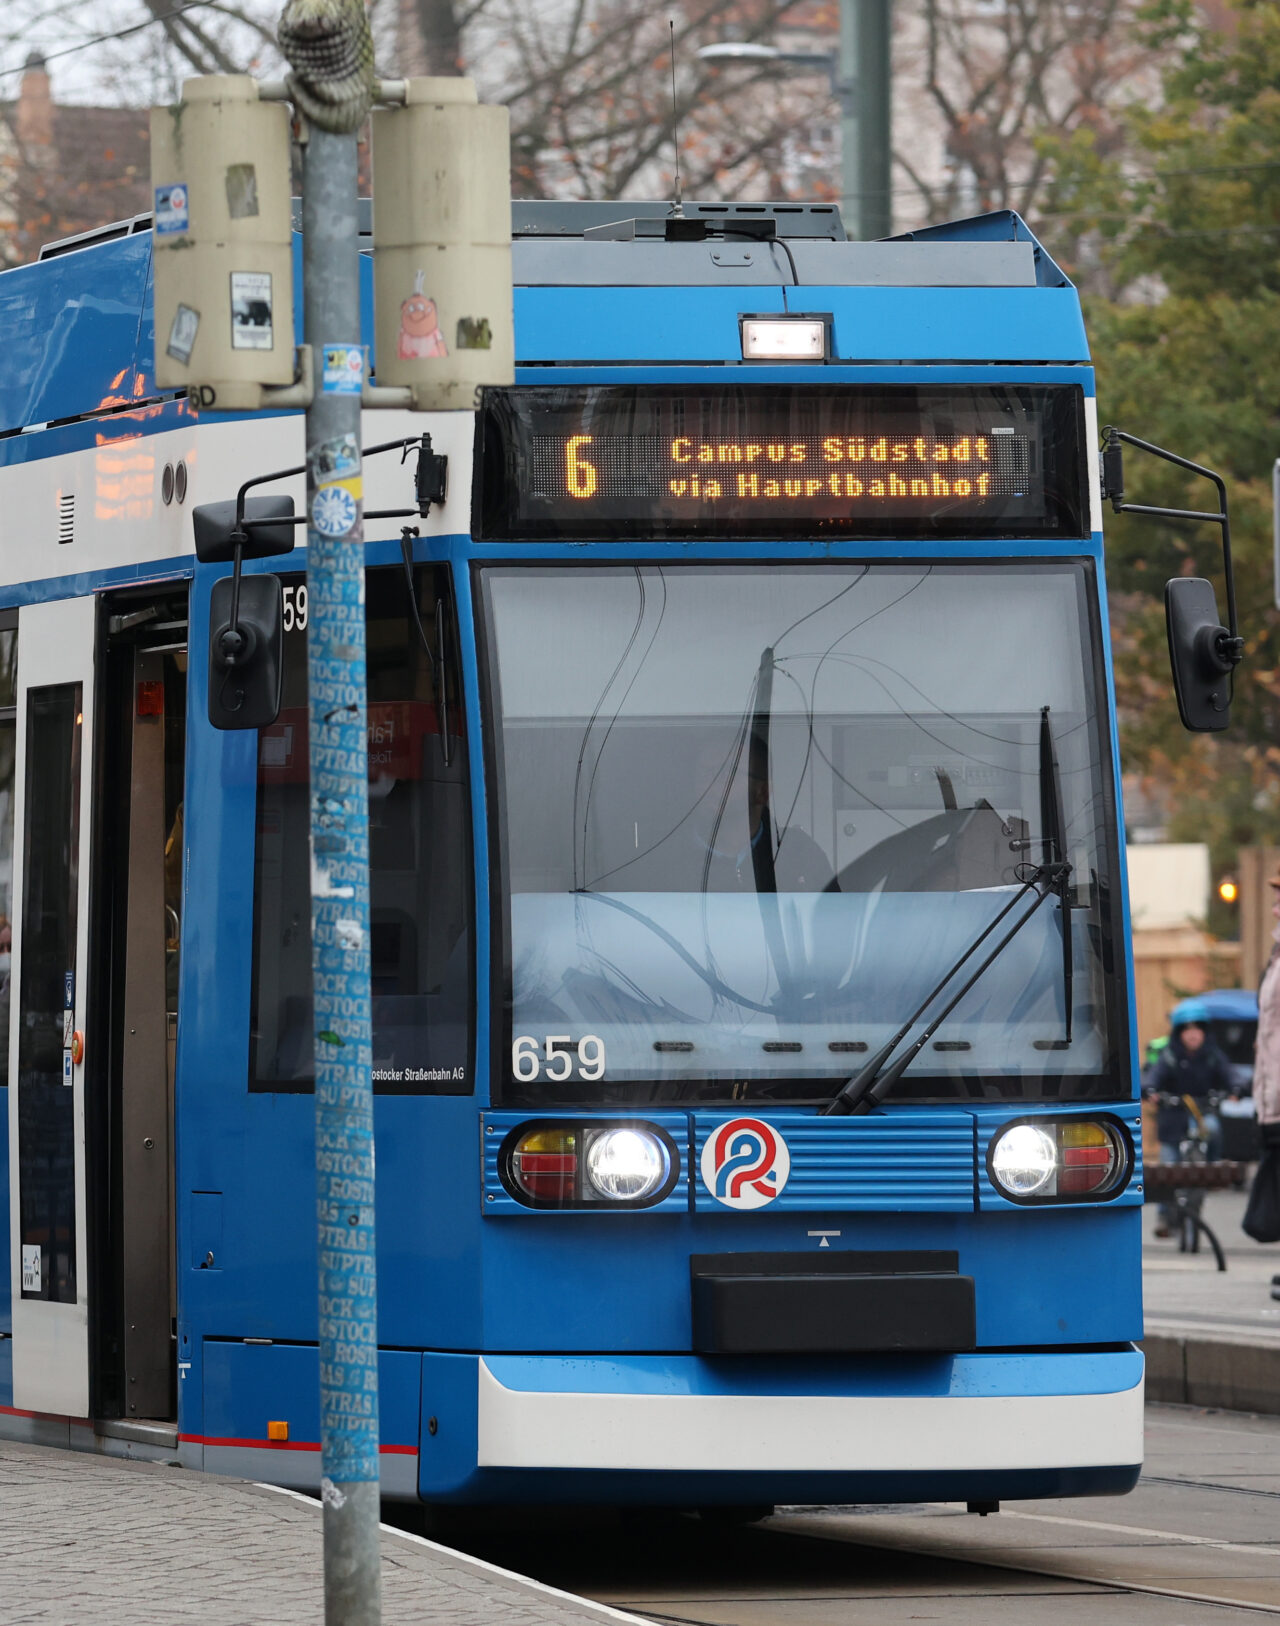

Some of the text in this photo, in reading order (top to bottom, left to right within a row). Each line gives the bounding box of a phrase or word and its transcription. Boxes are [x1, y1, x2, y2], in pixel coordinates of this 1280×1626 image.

[565, 436, 597, 498] 6
[821, 437, 989, 464] Südstadt
[670, 472, 723, 497] via
[282, 584, 308, 632] 59
[404, 1066, 451, 1081] Straßenbahn
[452, 1066, 466, 1081] AG
[511, 1035, 606, 1082] 659
